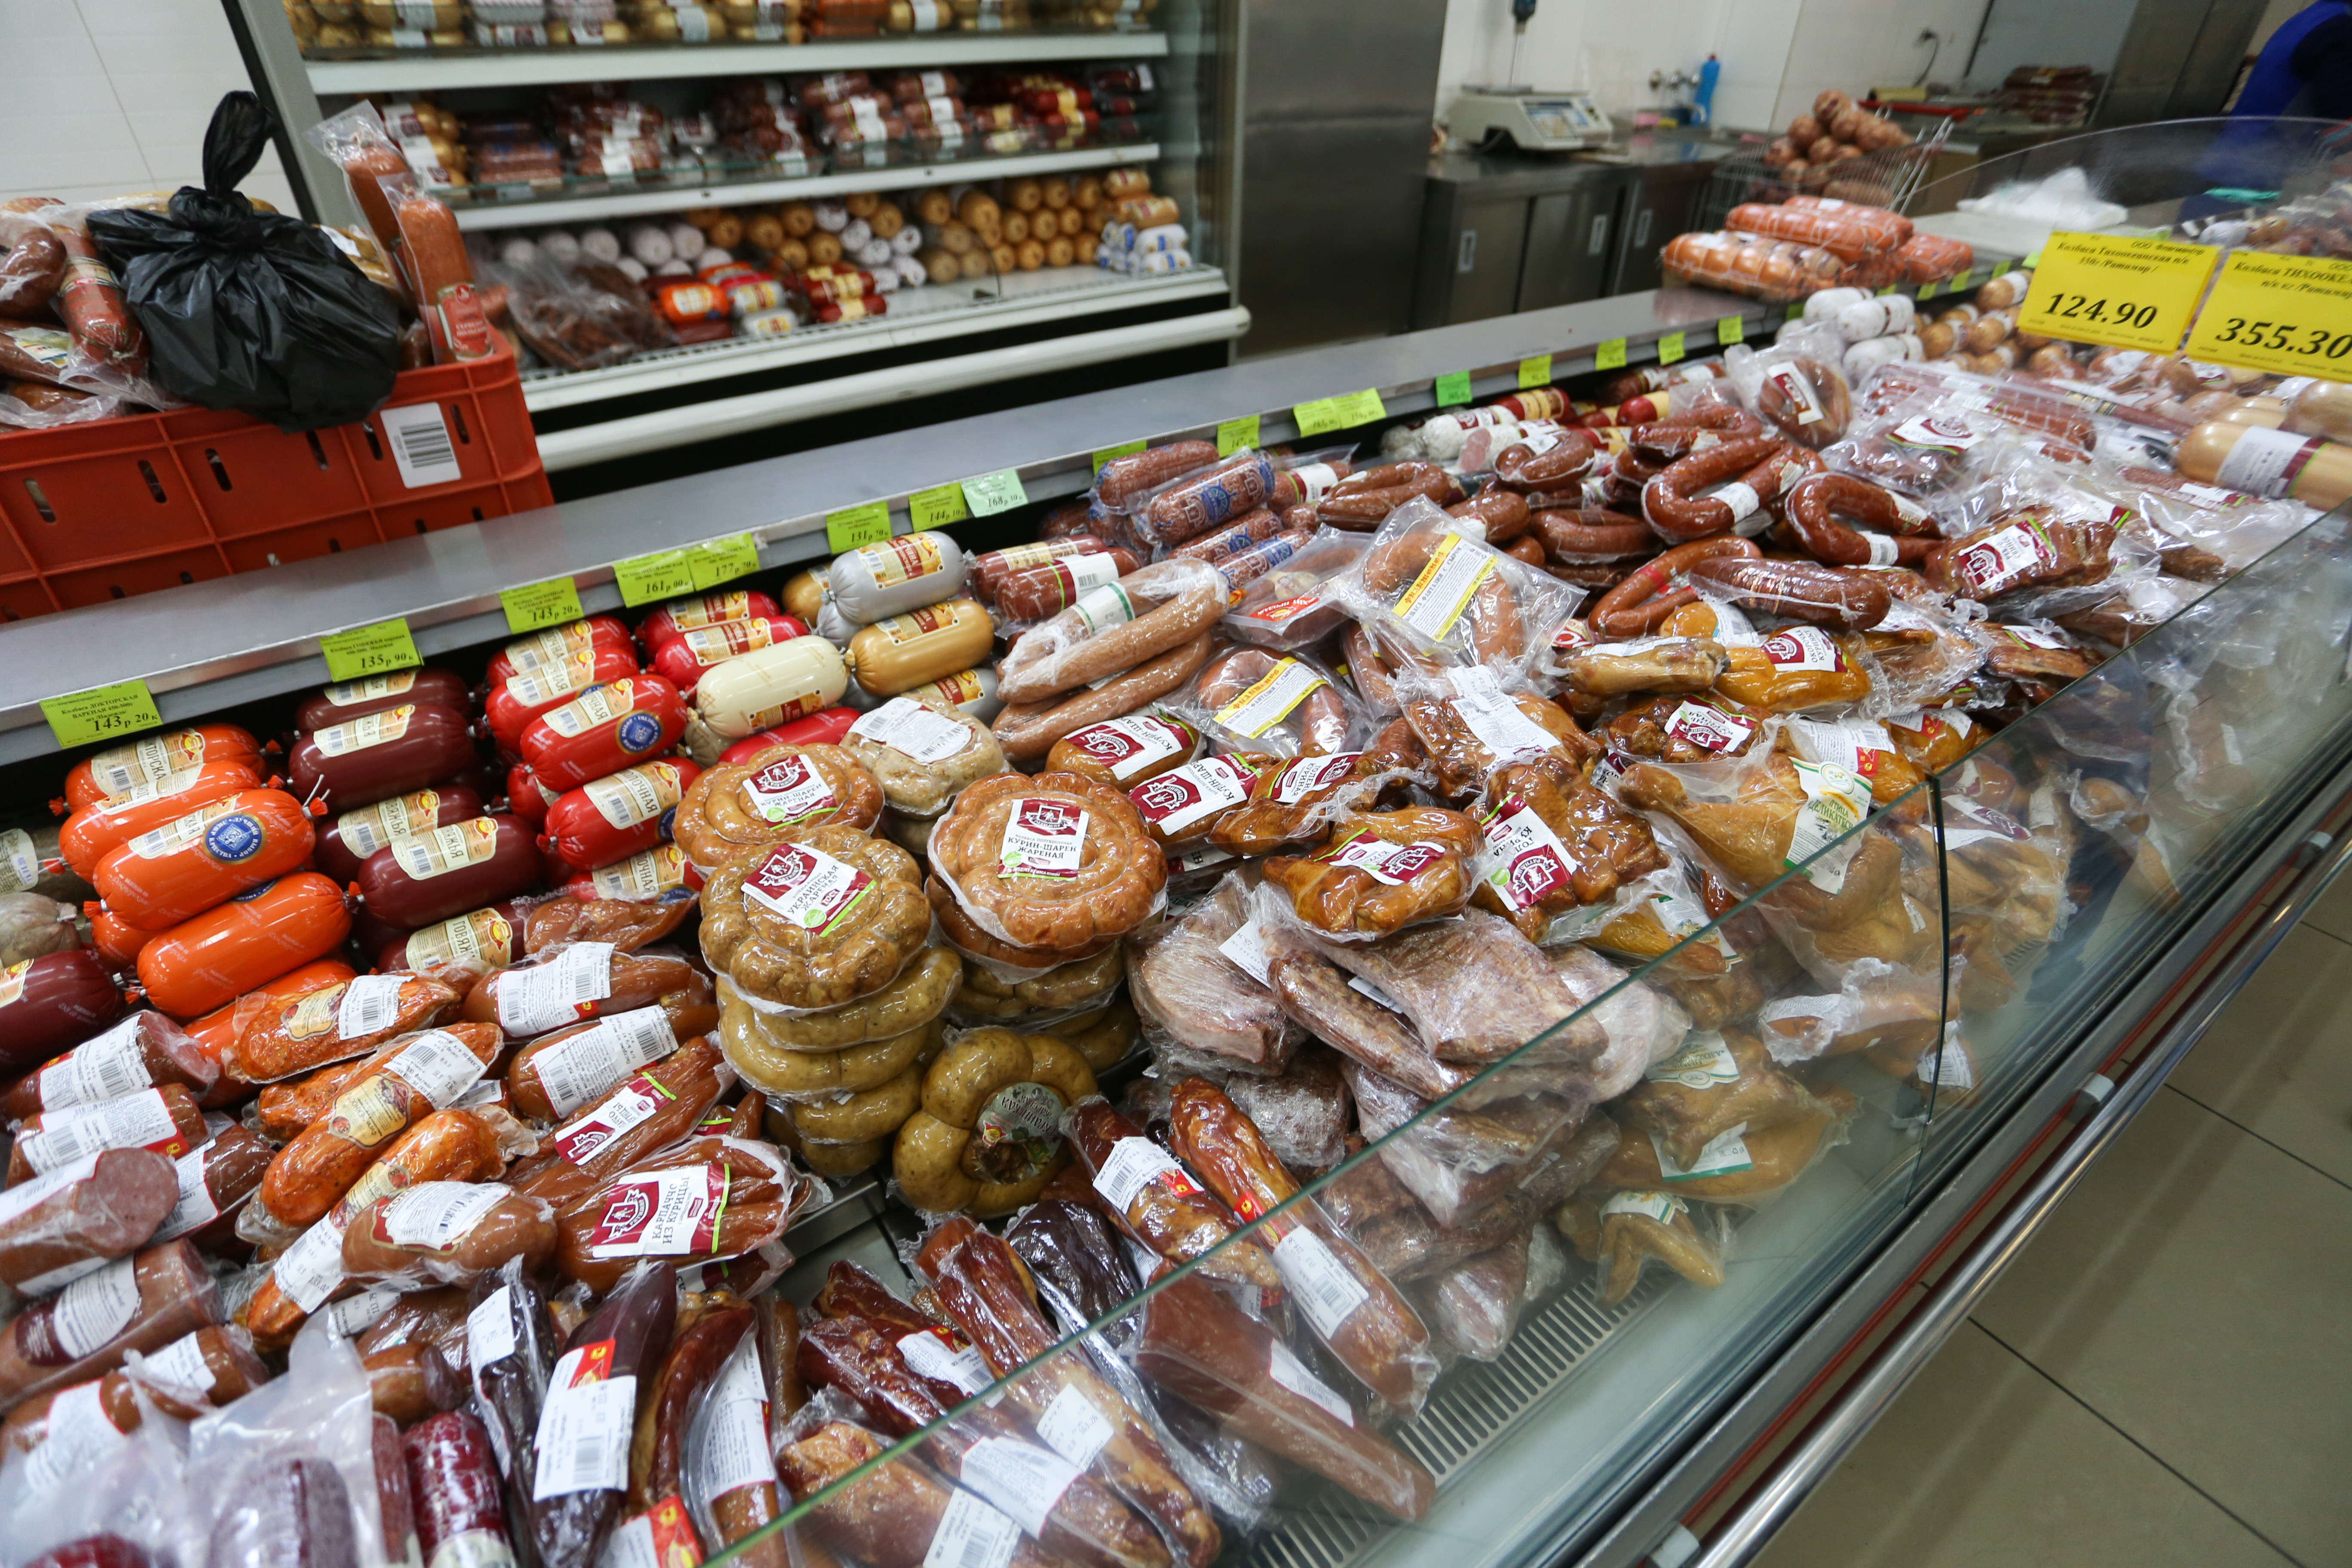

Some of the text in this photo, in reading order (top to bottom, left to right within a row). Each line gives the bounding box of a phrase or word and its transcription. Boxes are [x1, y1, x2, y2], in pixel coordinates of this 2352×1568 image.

[2057, 242, 2097, 254] Колбаса
[2098, 247, 2172, 262] Тихоокеанская
[2234, 262, 2281, 275] Колбаса
[2043, 293, 2157, 328] 124.90
[2214, 318, 2352, 358] 355.30
[851, 531, 867, 542] 131
[716, 564, 734, 576] 177
[646, 581, 664, 594] 161
[1422, 573, 1444, 601] ФАНТАЗИЯ
[533, 607, 552, 622] 143
[563, 606, 572, 614] 20
[361, 654, 384, 668] 135
[61, 694, 138, 715] Колбаса ДОКТОРСКАЯ
[72, 708, 107, 719] ВАРЕНАЯ
[94, 716, 121, 731] 143
[135, 713, 148, 723] 20
[1227, 707, 1250, 725] КОЛБАСА
[1292, 763, 1314, 796] КУРИНАЯ
[1302, 765, 1320, 792] ГОЛЕНЬ
[761, 784, 822, 806] КУРИН-ШАРЕН
[775, 793, 815, 806] ЖАРЕНАЯ
[1829, 799, 1849, 817] ПТИЦА
[1008, 837, 1076, 851] КУРИН-ШАРЕН
[1018, 846, 1064, 859] ЖАРЕНАЯ
[787, 865, 839, 914] УКРАИНСКАЯ
[801, 874, 839, 911] ЖАРЕНАЯ
[823, 890, 838, 906] ГОСТ
[364, 1120, 378, 1136] Филе
[652, 1183, 677, 1240] КАРПАЧЧО
[662, 1177, 690, 1245] ИЗ КУРИЦЫ
